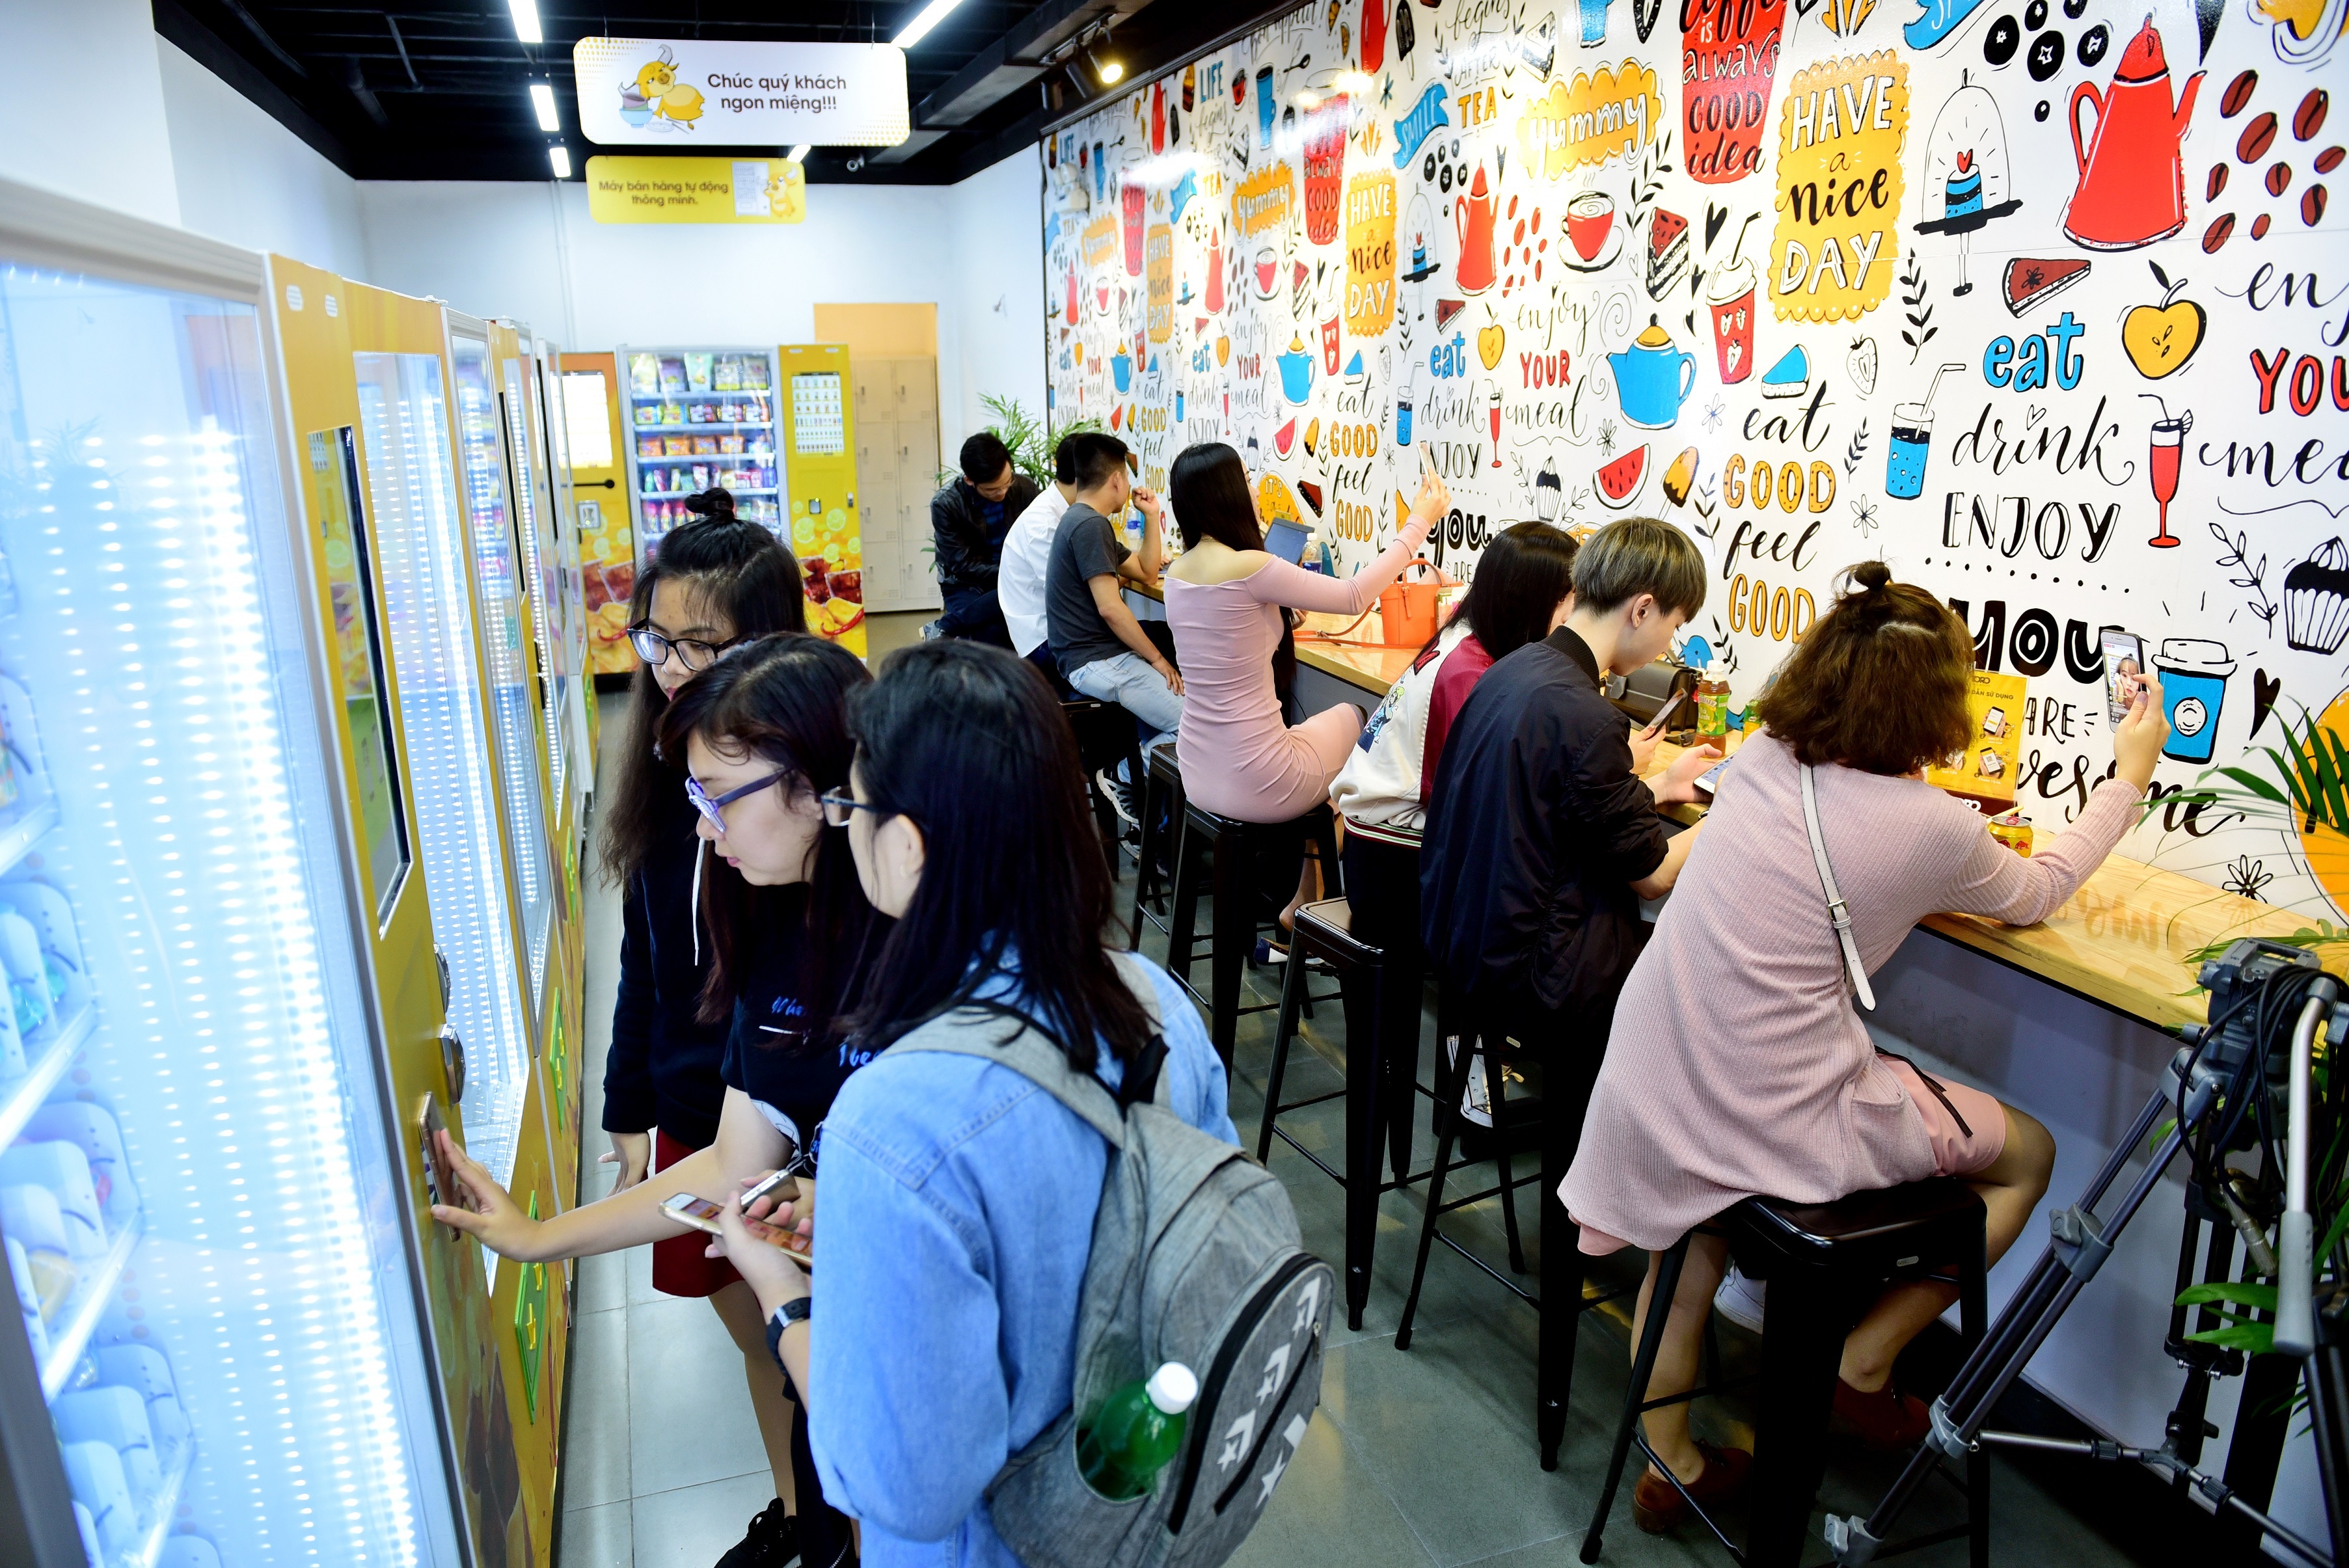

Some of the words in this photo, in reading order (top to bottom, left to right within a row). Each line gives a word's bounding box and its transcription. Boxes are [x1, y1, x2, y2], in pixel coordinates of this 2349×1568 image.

[1700, 19, 1713, 43] is
[707, 72, 754, 88] Chúc
[759, 73, 789, 91] quý
[795, 74, 847, 89] khách
[1200, 60, 1223, 103] LIFE
[721, 97, 764, 113] ngon
[770, 94, 837, 113] miệng!!!
[1402, 90, 1437, 157] SMILE
[1458, 87, 1497, 128] TEA
[1689, 90, 1765, 134] GOOD
[1791, 74, 1895, 153] HAVE
[1529, 93, 1647, 179] yummy
[1689, 131, 1766, 176] idea
[1830, 152, 1851, 172] a
[599, 180, 623, 192] Máy
[627, 180, 649, 191] bán
[653, 180, 681, 193] hàng
[1203, 171, 1221, 198] TEA
[1350, 182, 1391, 228] HAVE
[1775, 169, 1889, 226] nice
[1237, 182, 1290, 236] yummy
[1308, 213, 1340, 242] idea
[1148, 232, 1170, 264] HAVE
[1348, 241, 1392, 274] nice
[1778, 231, 1883, 295] DAY
[1149, 275, 1171, 299] nice
[1348, 278, 1391, 319] DAY
[1149, 303, 1171, 330] DAY
[1230, 307, 1272, 357] enjoy
[1507, 290, 1601, 357] enjoy
[1087, 355, 1102, 376] YOUR
[1192, 340, 1210, 373] eat
[1237, 353, 1261, 381] YOUR
[1430, 331, 1466, 379] eat
[1519, 349, 1571, 390] YOUR
[1983, 312, 2085, 392] eat
[1143, 372, 1165, 403] eat
[1188, 374, 1221, 412] drink
[1230, 369, 1270, 414] meal
[1337, 371, 1376, 418] eat
[1421, 379, 1486, 433] drink
[1506, 374, 1588, 438] meal
[1141, 405, 1167, 433] GOOD
[1188, 417, 1220, 444] ENJOY
[1743, 380, 1836, 453] eat
[1143, 435, 1165, 467] feel
[1330, 420, 1378, 458] GOOD
[1952, 394, 2135, 486] drink
[1145, 463, 1165, 494] GOOD
[1265, 478, 1283, 498] IT'S
[1333, 461, 1373, 504] feel
[1723, 453, 1836, 514] GOOD
[1336, 498, 1374, 543] GOOD
[1942, 491, 2121, 563] ENJOY
[1723, 520, 1821, 580] feel
[1728, 573, 1816, 644] GOOD
[1971, 676, 1991, 684] ORO
[1996, 693, 2015, 701] DỤNG
[2024, 696, 2077, 744] ARE
